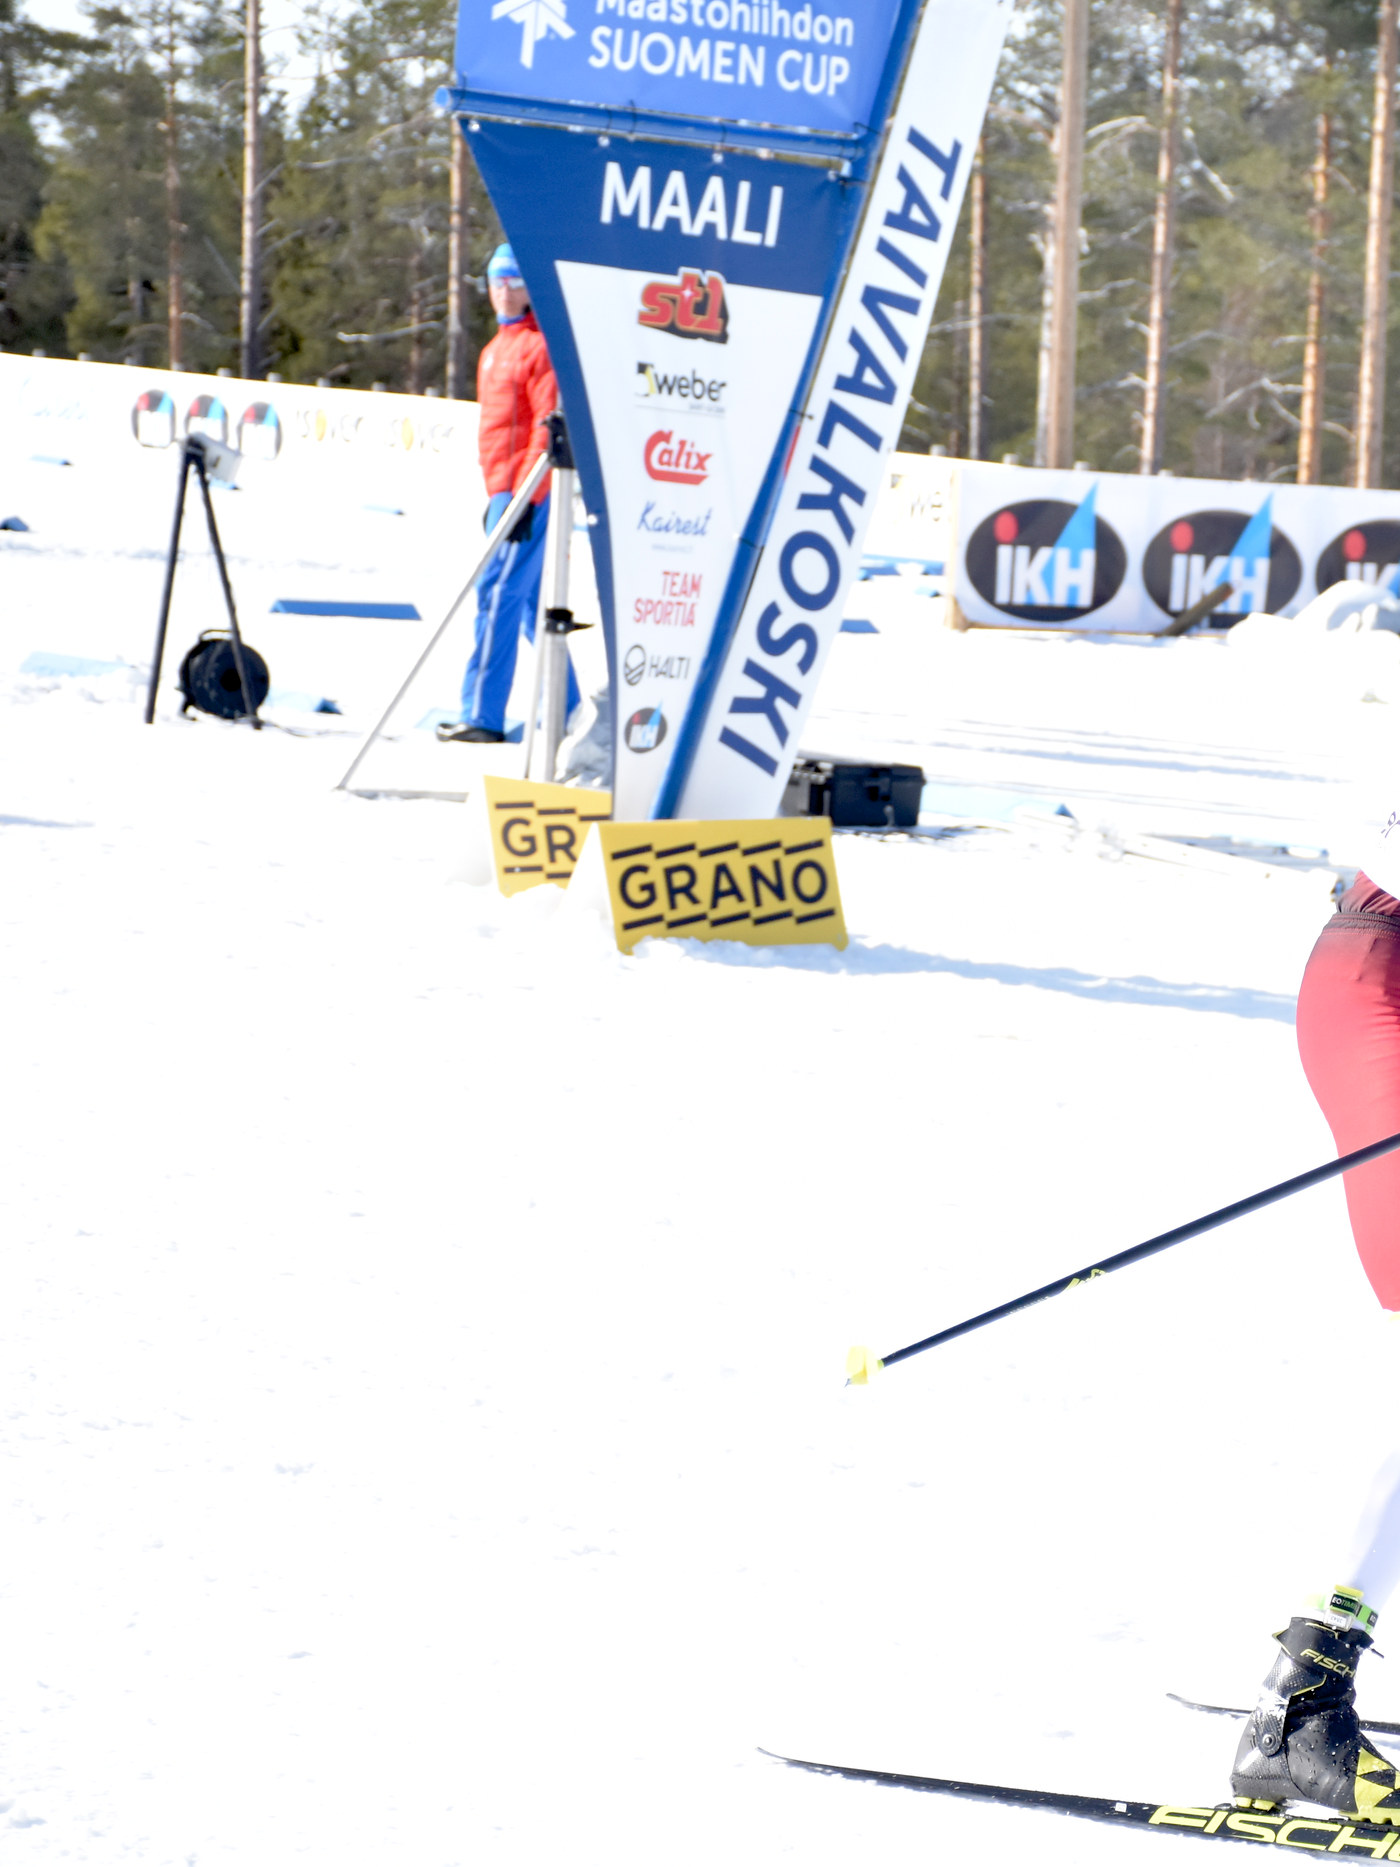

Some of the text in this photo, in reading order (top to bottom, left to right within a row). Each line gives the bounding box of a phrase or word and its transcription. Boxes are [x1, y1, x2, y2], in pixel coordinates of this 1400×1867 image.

[588, 25, 850, 96] SUOMEN CUP
[600, 162, 783, 248] MAALI
[654, 369, 727, 401] weber
[644, 430, 713, 485] Calix
[719, 125, 962, 778] TAIVALKOSKI
[661, 571, 702, 598] TEAM
[633, 599, 697, 627] SPORTIA
[648, 656, 690, 680] HALTI
[619, 859, 828, 910] GRANO
